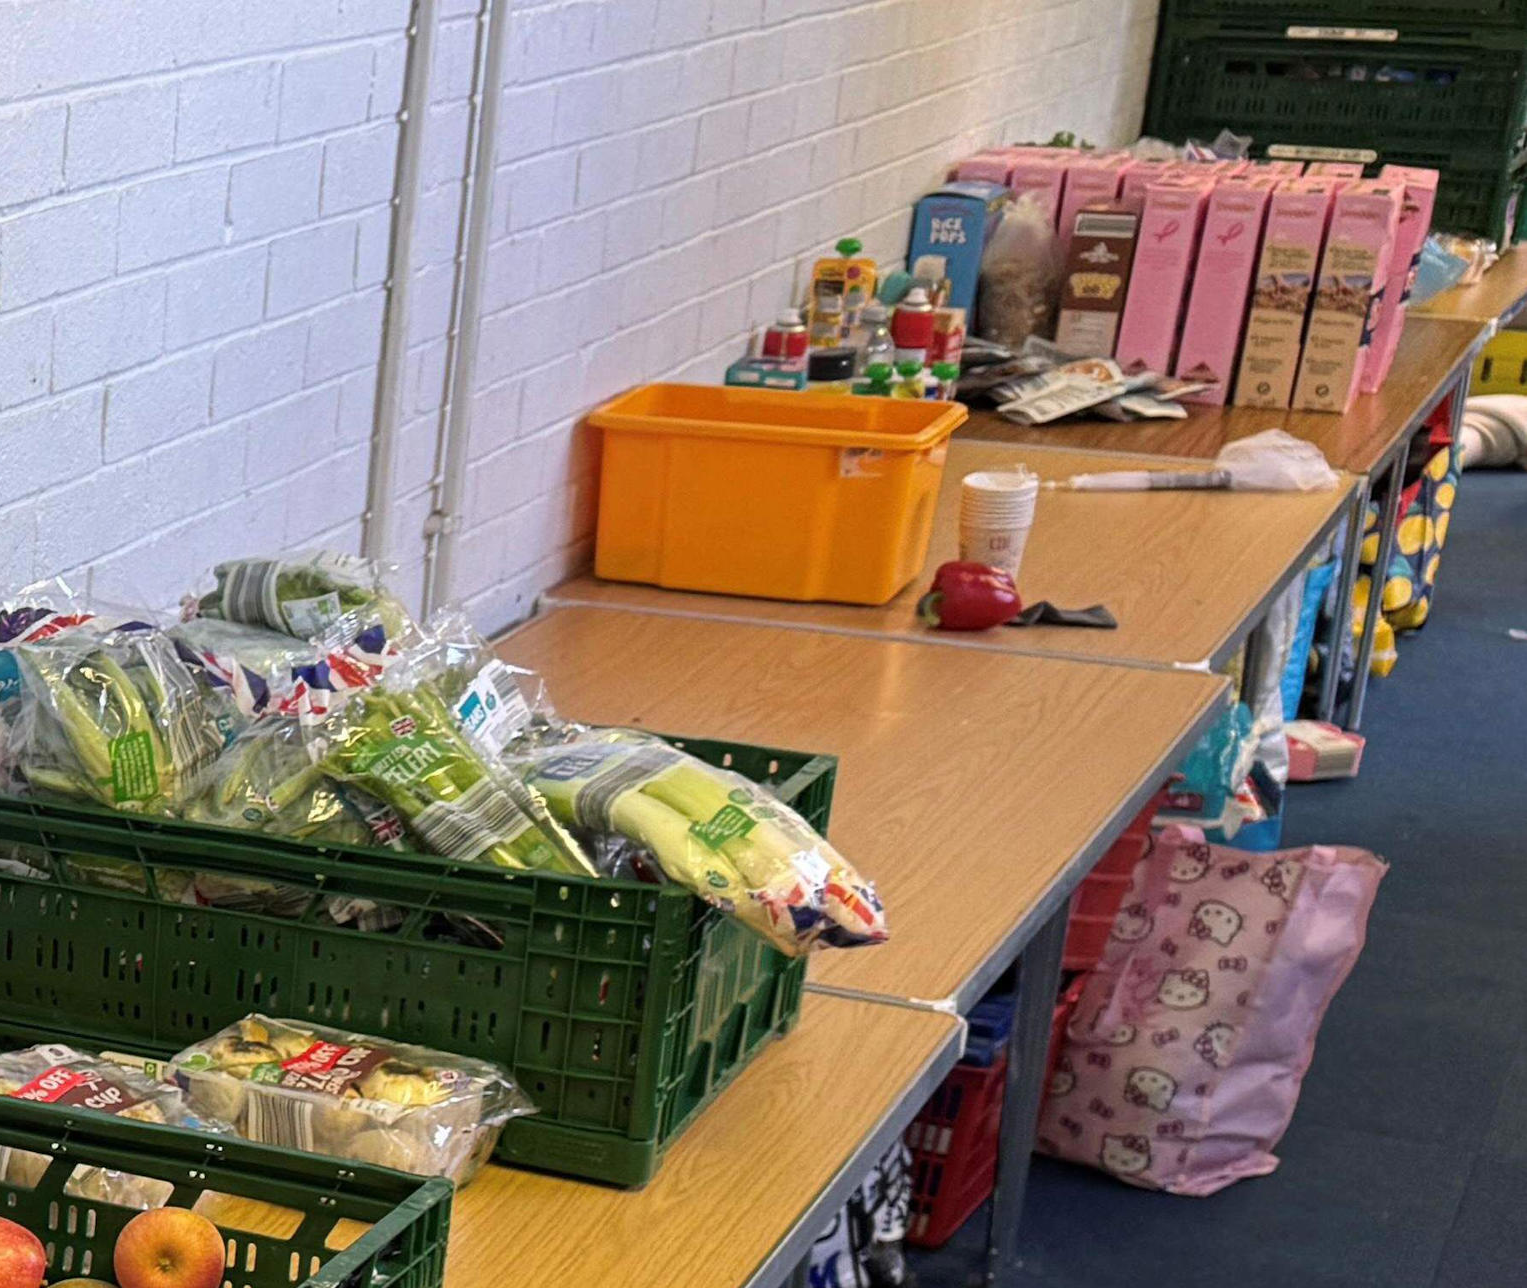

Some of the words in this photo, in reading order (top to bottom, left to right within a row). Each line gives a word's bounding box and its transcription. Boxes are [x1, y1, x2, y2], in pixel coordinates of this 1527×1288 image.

[383, 741, 442, 786] CELERY
[39, 1069, 72, 1091] OFF
[84, 1087, 123, 1109] CUP
